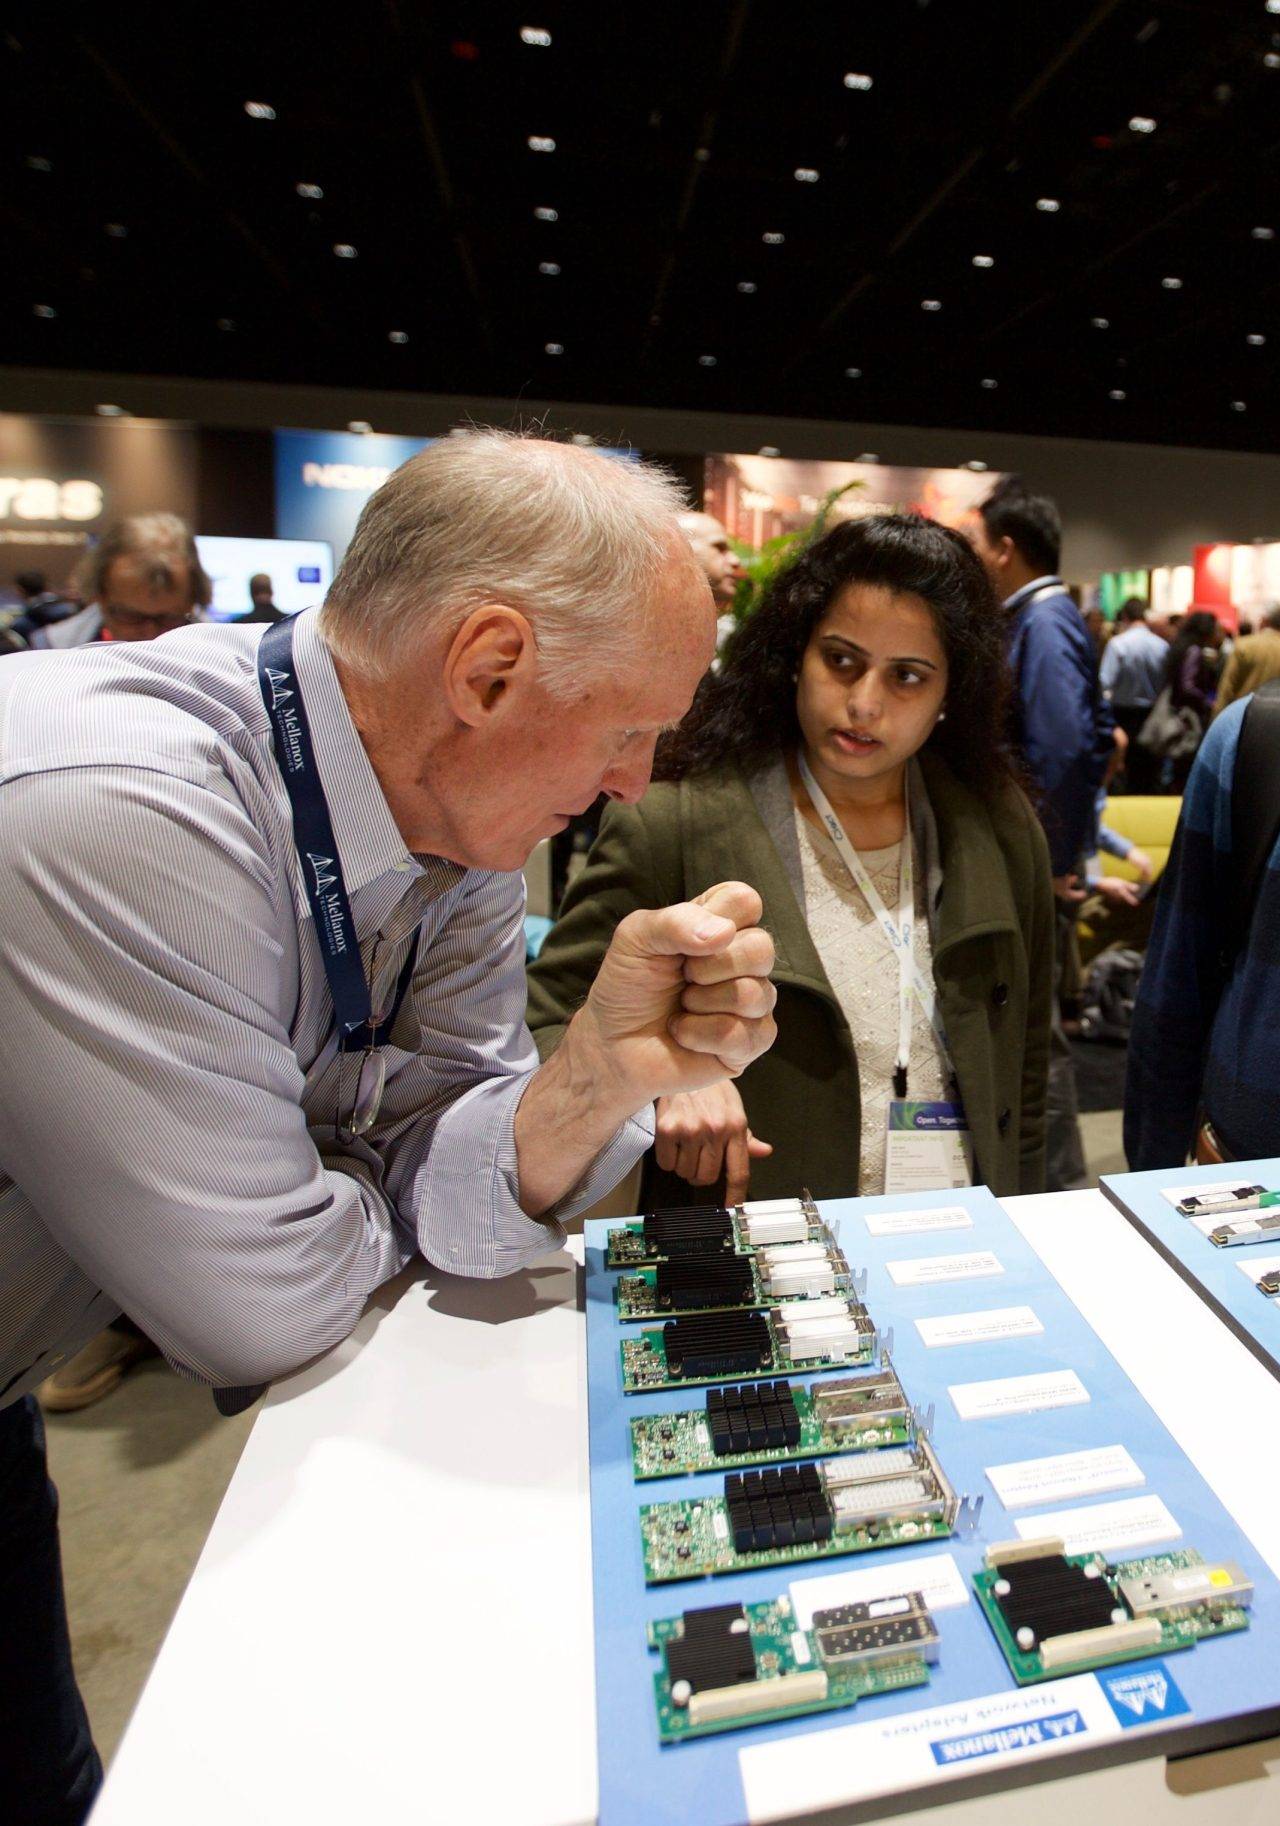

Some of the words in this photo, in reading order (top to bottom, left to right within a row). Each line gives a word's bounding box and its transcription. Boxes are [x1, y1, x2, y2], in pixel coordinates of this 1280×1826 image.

[282, 707, 305, 771] Mellanox
[325, 892, 348, 955] Mellanox
[939, 1718, 1045, 1762] Mellanox
